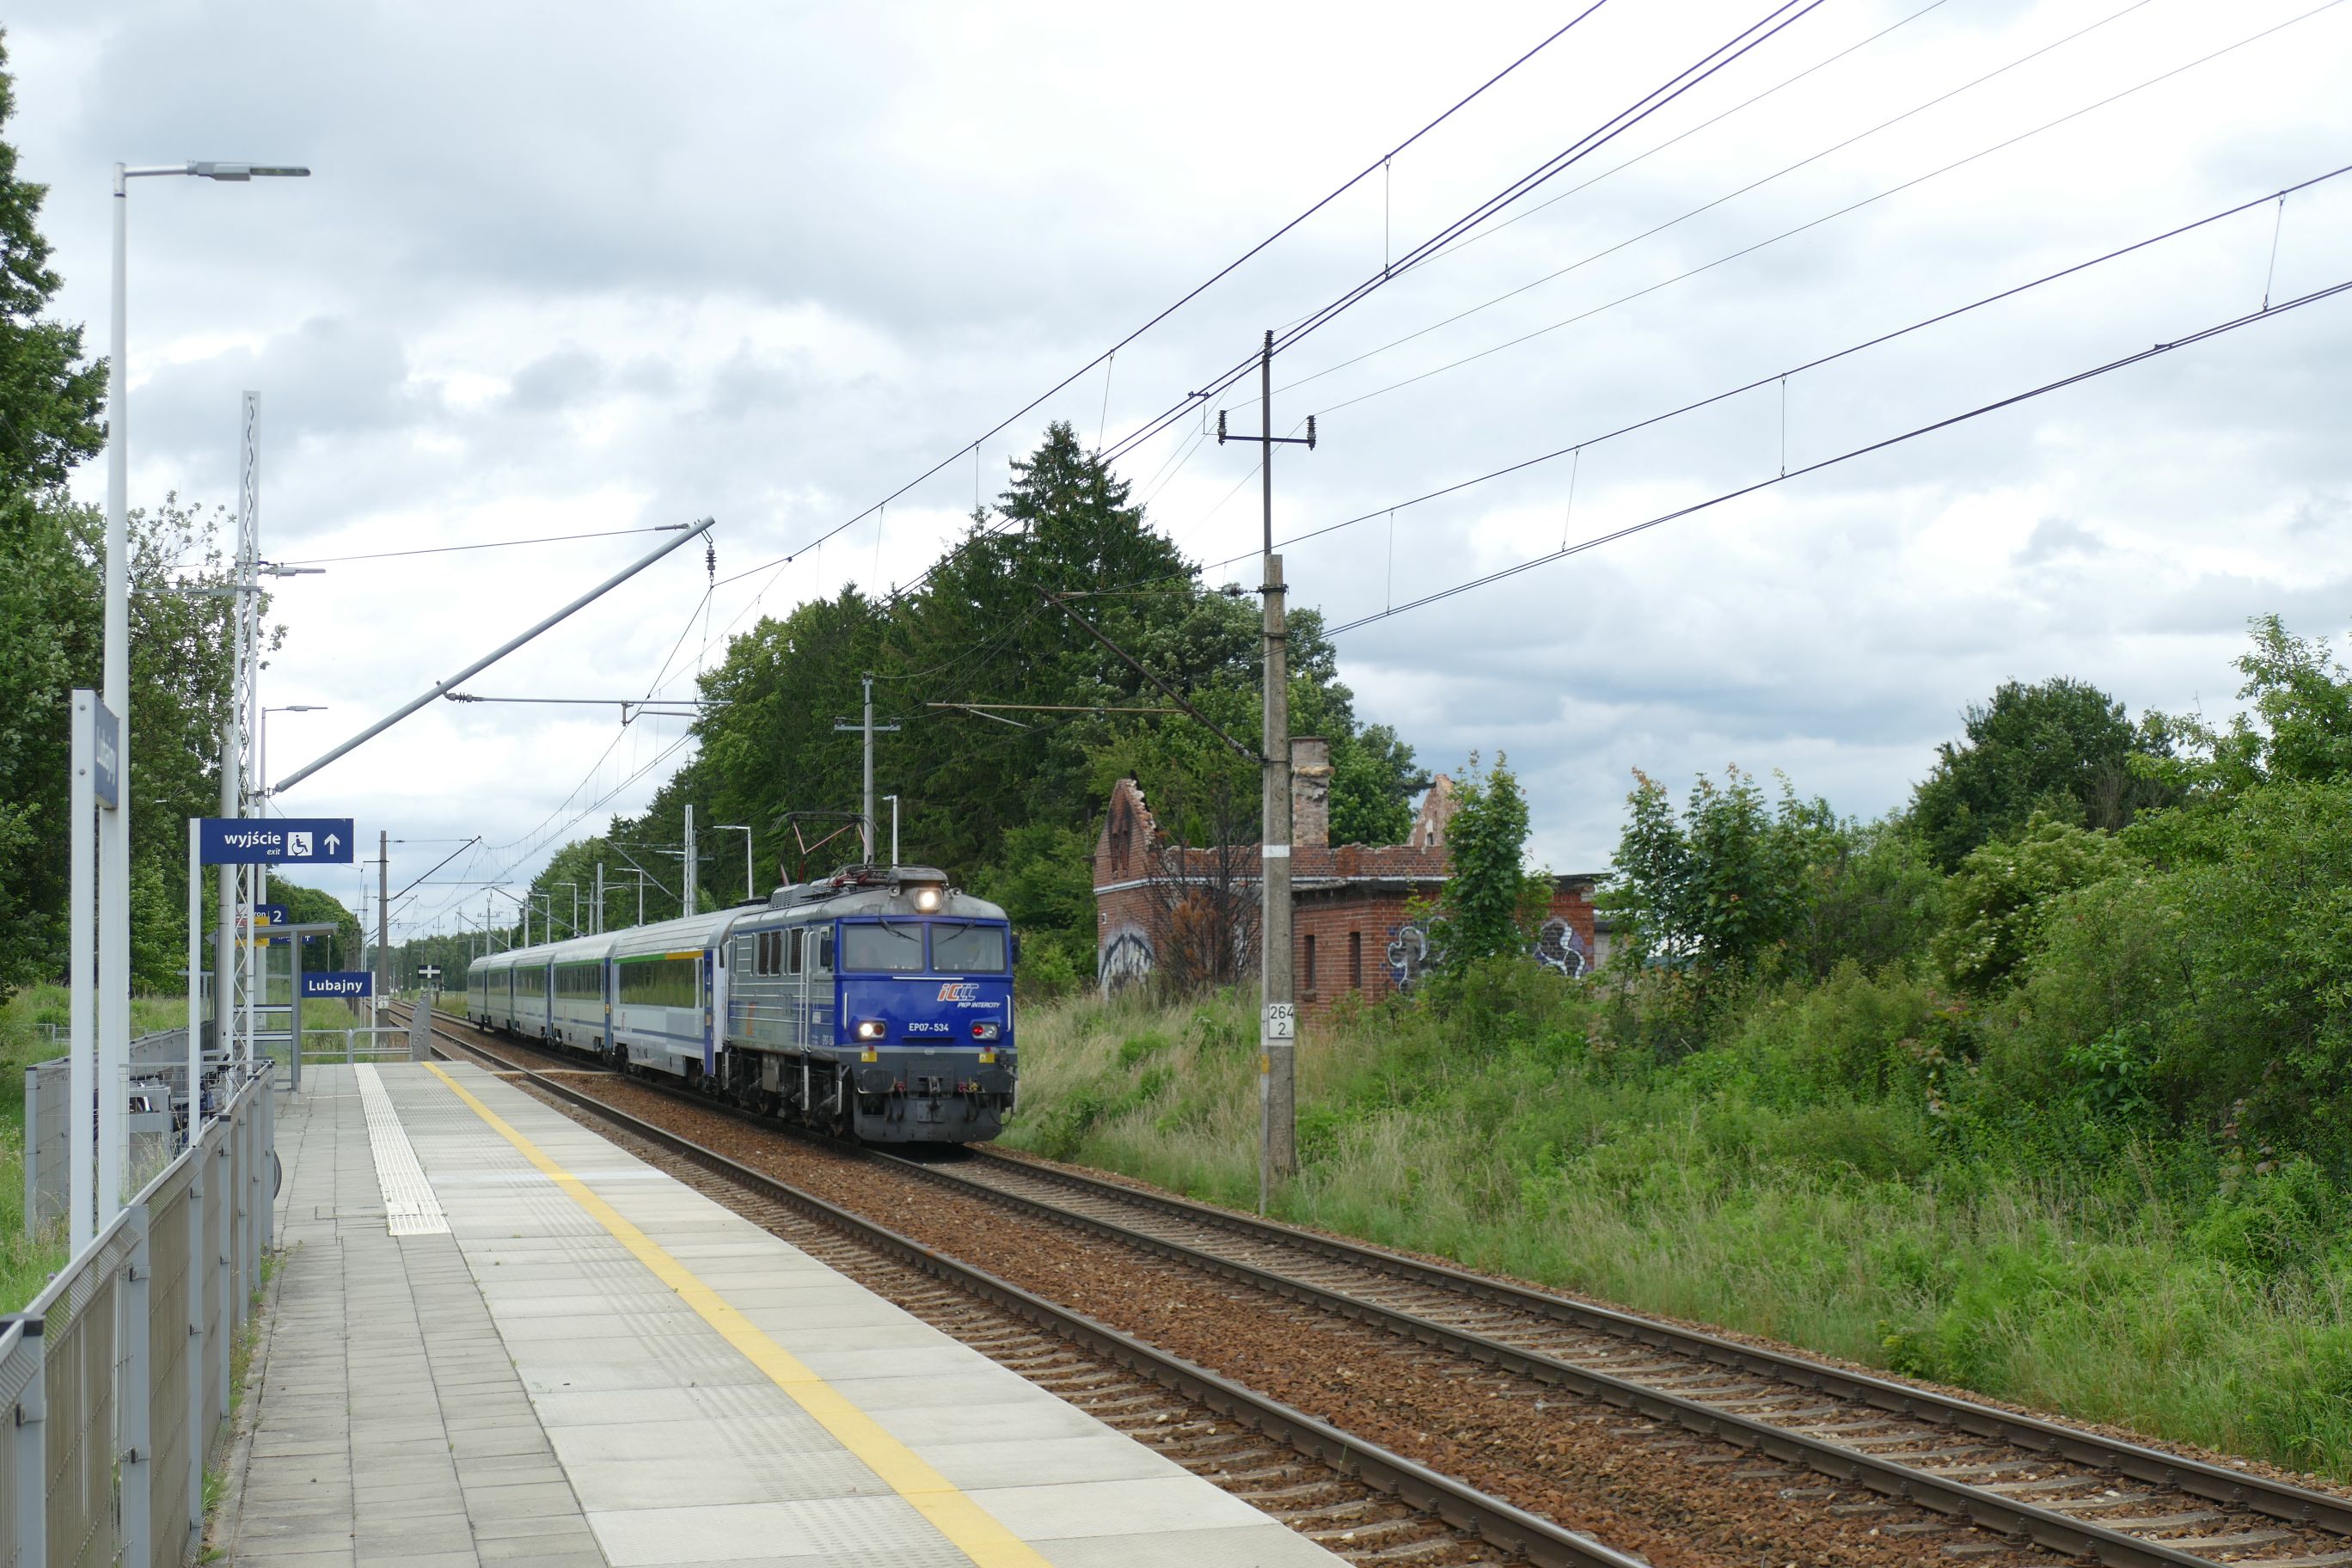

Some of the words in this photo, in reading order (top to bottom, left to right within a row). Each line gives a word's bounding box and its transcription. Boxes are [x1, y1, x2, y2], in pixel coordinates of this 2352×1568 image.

[224, 831, 281, 848] wyjście
[273, 910, 282, 922] 2
[309, 979, 363, 994] Lubajny
[1271, 1006, 1294, 1020] 264
[909, 1022, 949, 1032] EP07-534
[1278, 1022, 1286, 1035] 2
